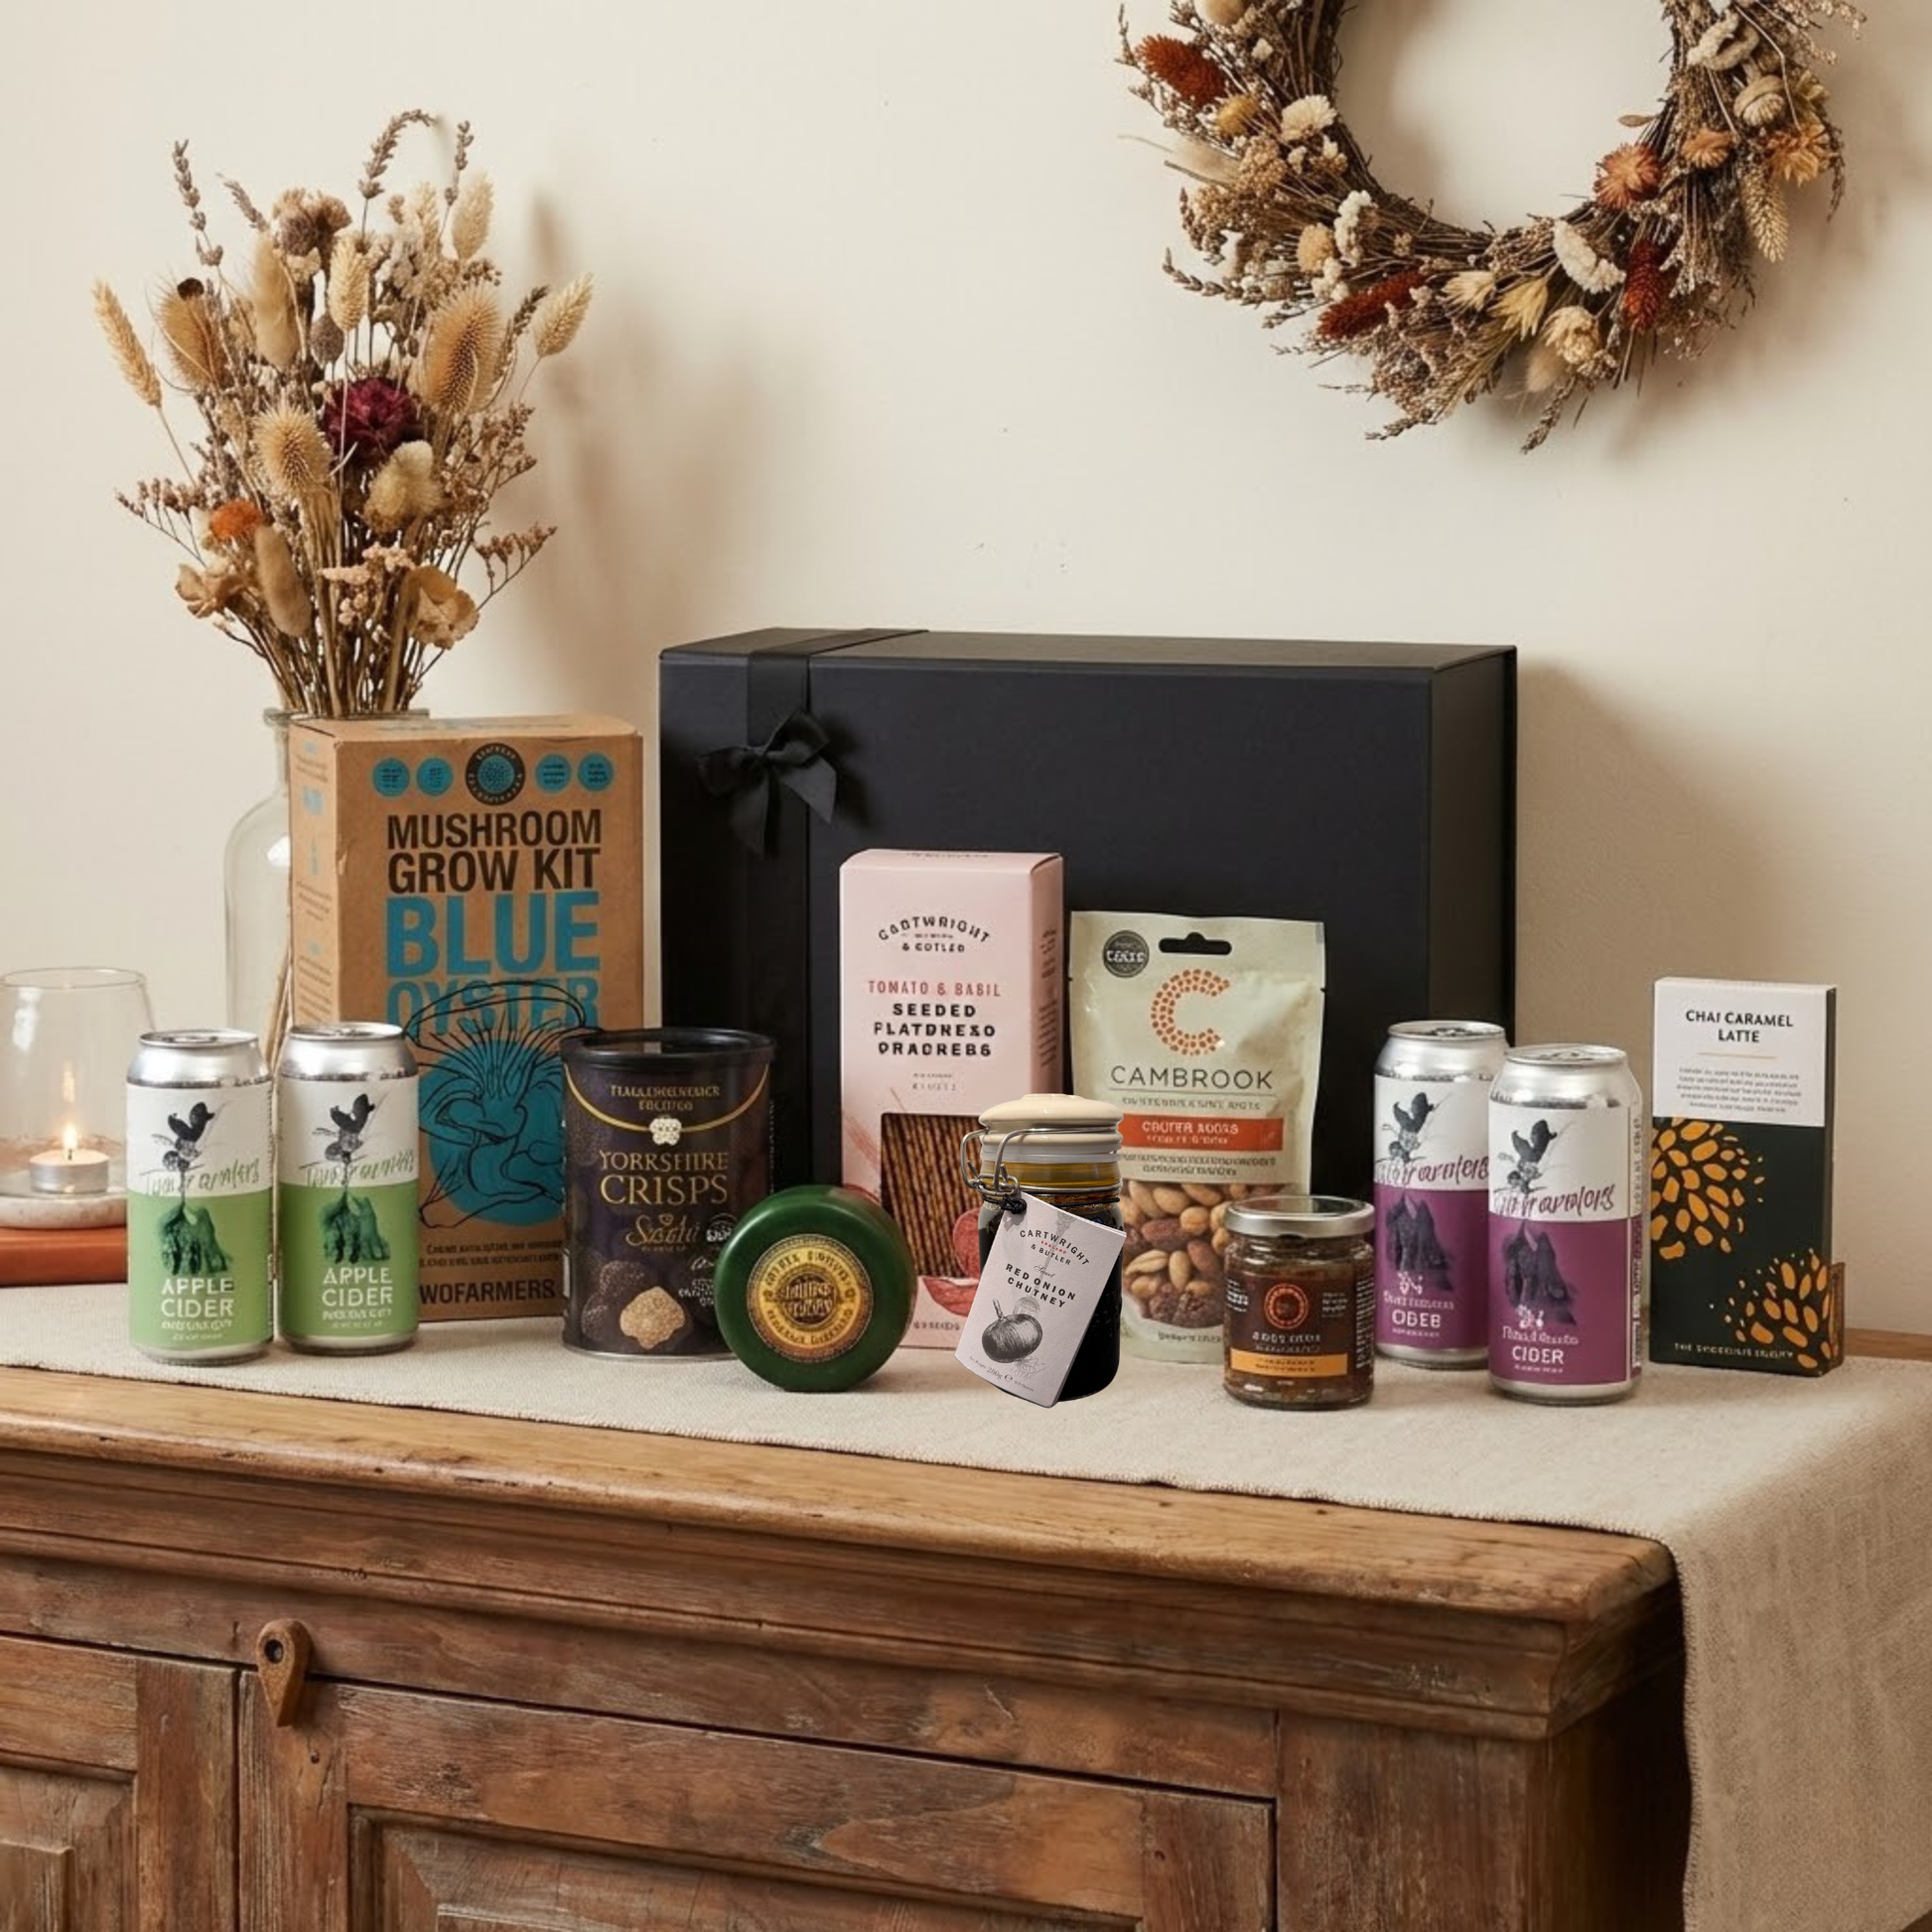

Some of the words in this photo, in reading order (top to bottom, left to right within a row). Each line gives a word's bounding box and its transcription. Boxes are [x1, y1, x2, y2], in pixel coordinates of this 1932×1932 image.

[388, 809, 602, 850] MUSHROOM
[388, 851, 518, 894] GROW
[534, 847, 601, 890] KIT
[386, 891, 601, 977] BLUE
[869, 980, 929, 995] TOMATO
[893, 1003, 976, 1018] SEEDED
[1686, 1009, 1722, 1025] CHAI
[1724, 1011, 1794, 1028] CARAMEL
[1718, 1029, 1760, 1043] LATTE
[1110, 1064, 1274, 1090] CAMBROOK
[600, 1173, 729, 1206] CRISPS
[1020, 1229, 1090, 1266] CARTWRIGHT
[1038, 1247, 1071, 1266] BUTLER
[322, 1267, 393, 1286] APPLE
[1005, 1263, 1030, 1281] RED
[1034, 1278, 1076, 1301] ONION
[322, 1287, 393, 1308] CIDER
[1007, 1277, 1066, 1309] CHUTNEY
[161, 1298, 235, 1318] CIDER
